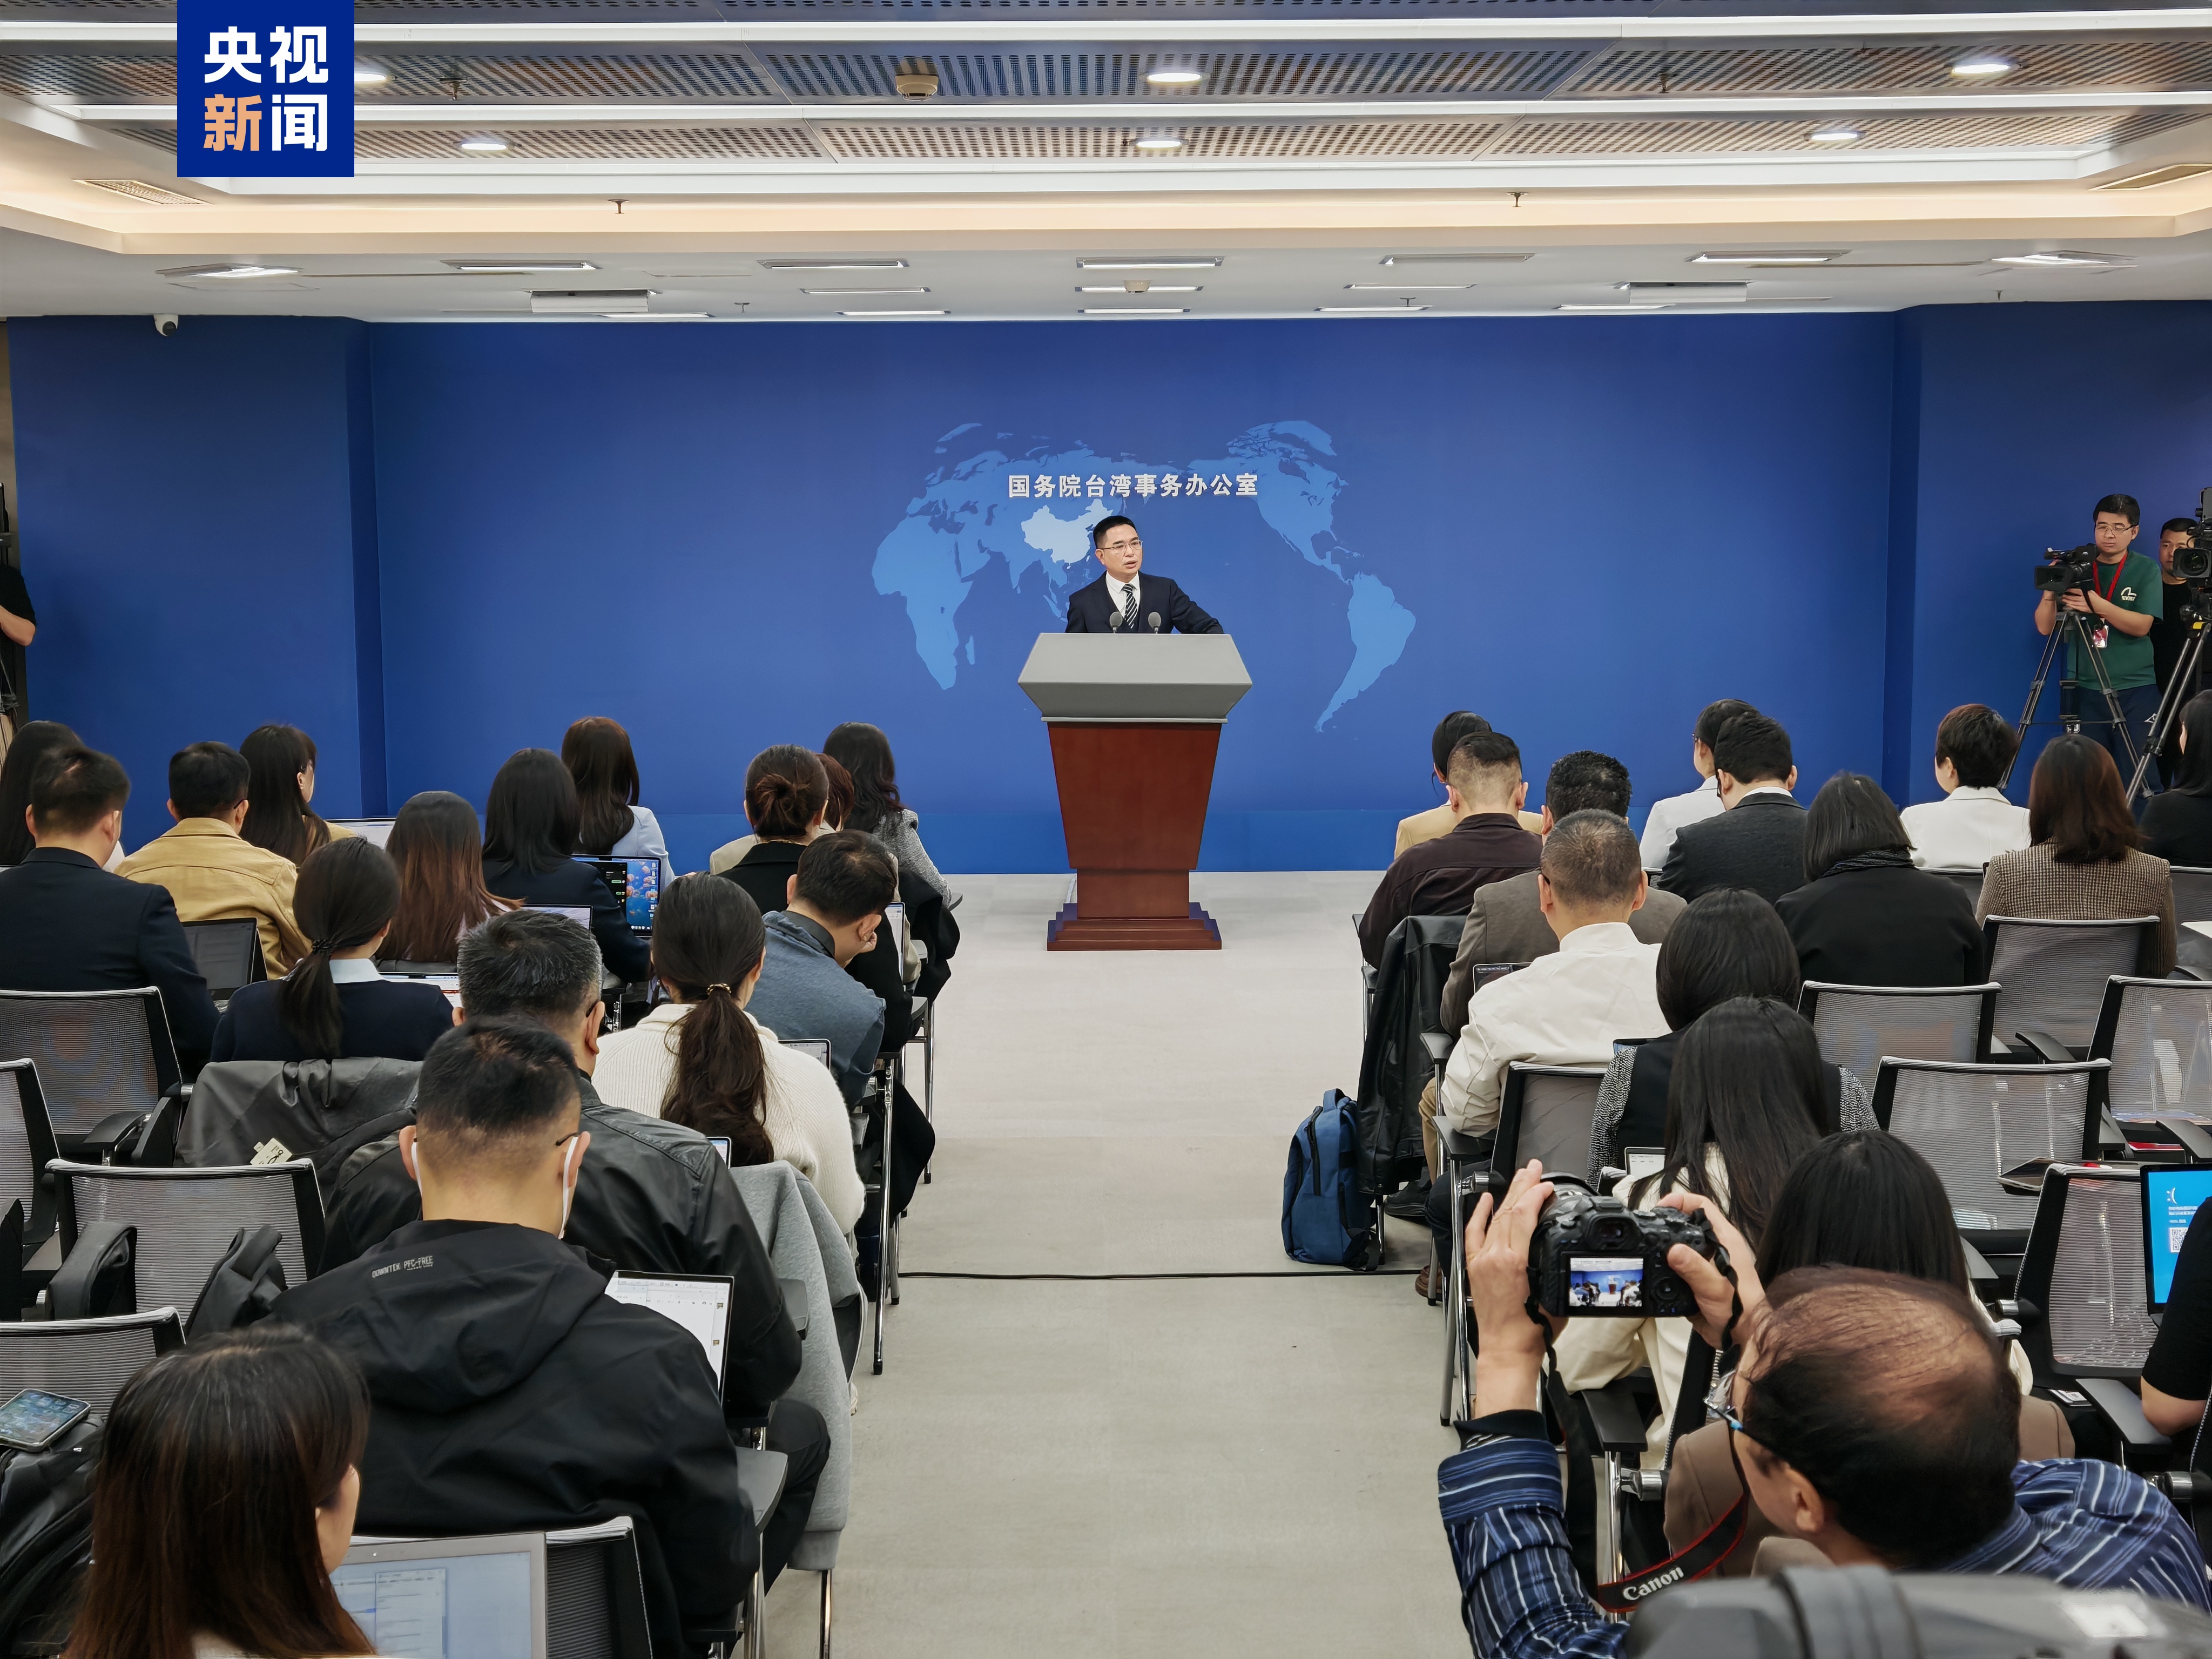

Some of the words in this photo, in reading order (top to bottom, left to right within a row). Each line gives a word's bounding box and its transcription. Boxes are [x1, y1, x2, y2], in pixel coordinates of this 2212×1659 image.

[1008, 474, 1258, 497] 国务院台湾事务办公室
[1623, 1567, 1684, 1600] Canon
